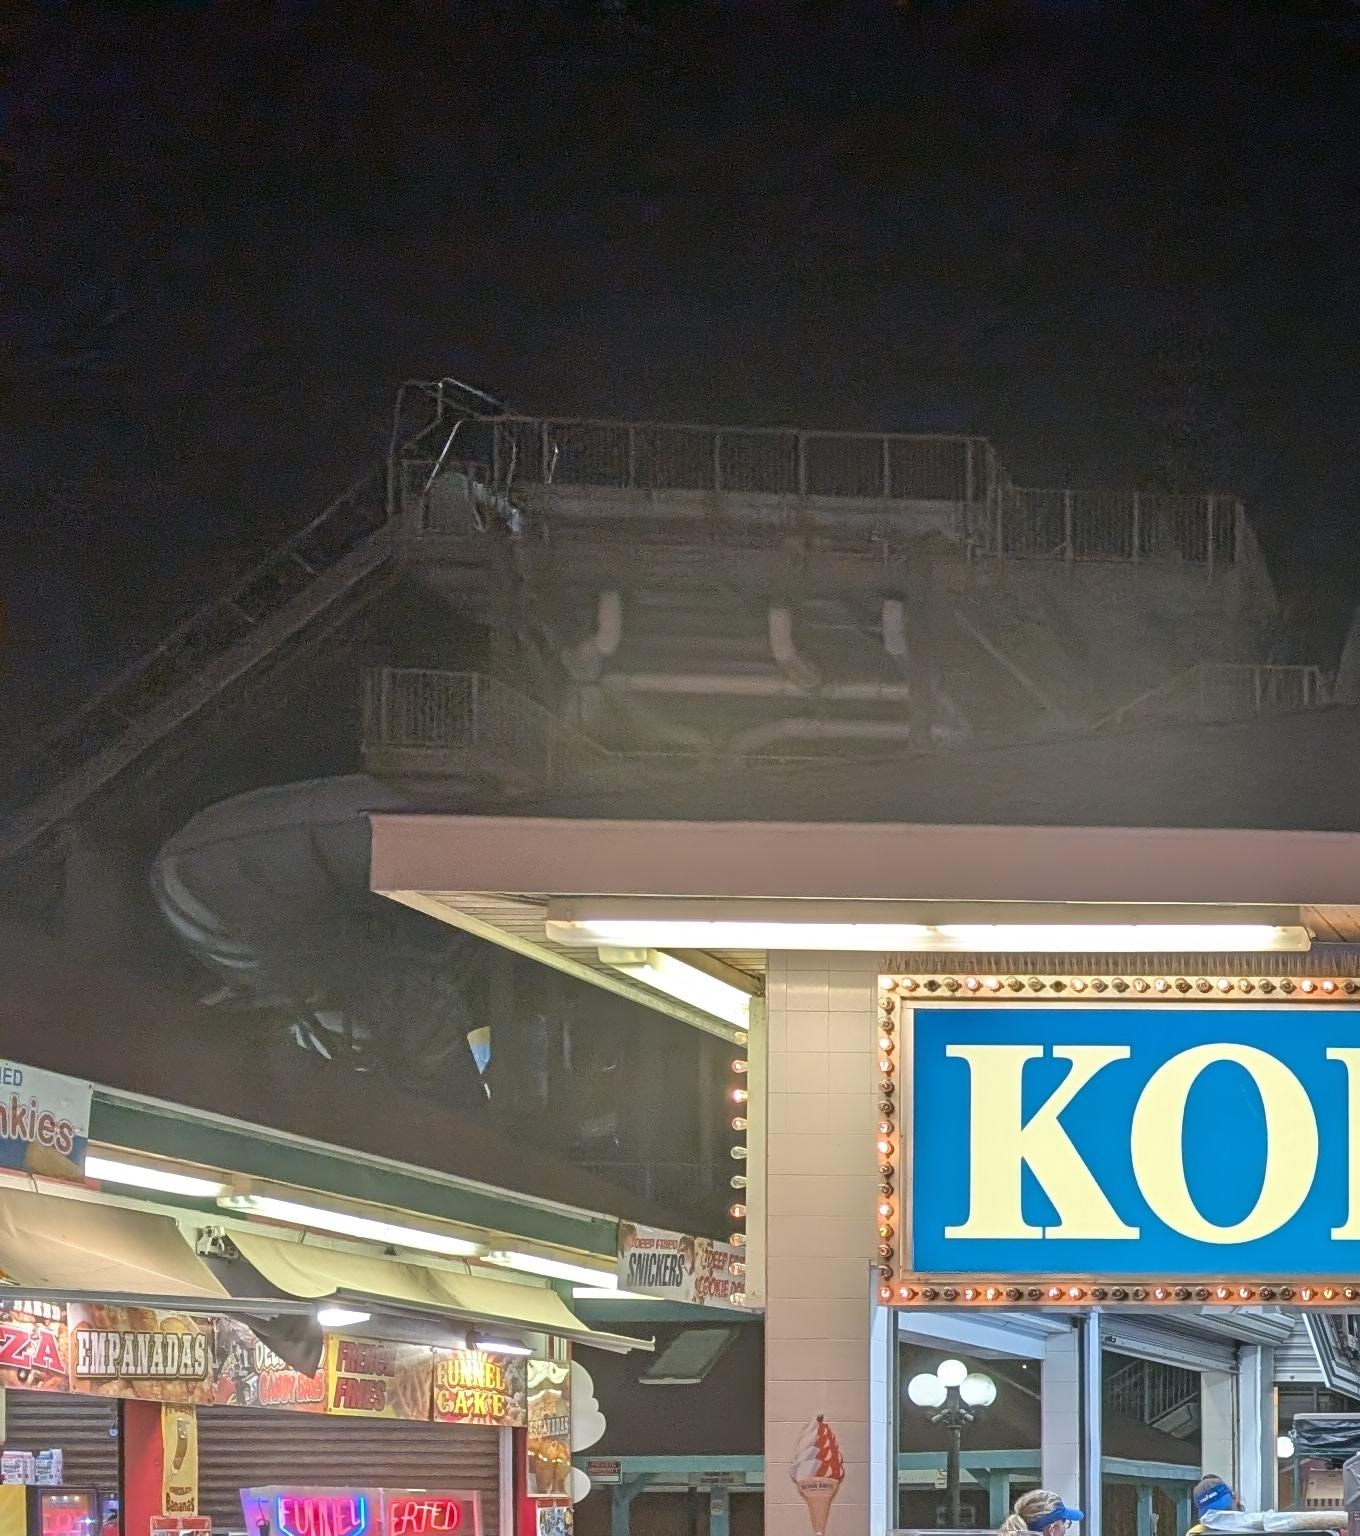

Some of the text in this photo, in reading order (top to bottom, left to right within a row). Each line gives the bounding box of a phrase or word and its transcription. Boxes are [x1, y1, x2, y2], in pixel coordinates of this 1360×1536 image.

[635, 1239, 655, 1249] DEEP
[627, 1252, 685, 1288] SNICKERS
[75, 1330, 206, 1377] EMPANADAS
[436, 1358, 506, 1390] FUNNEL
[333, 1377, 387, 1412] FRIES
[436, 1389, 506, 1417] CAKE
[165, 1492, 195, 1513] Bananas
